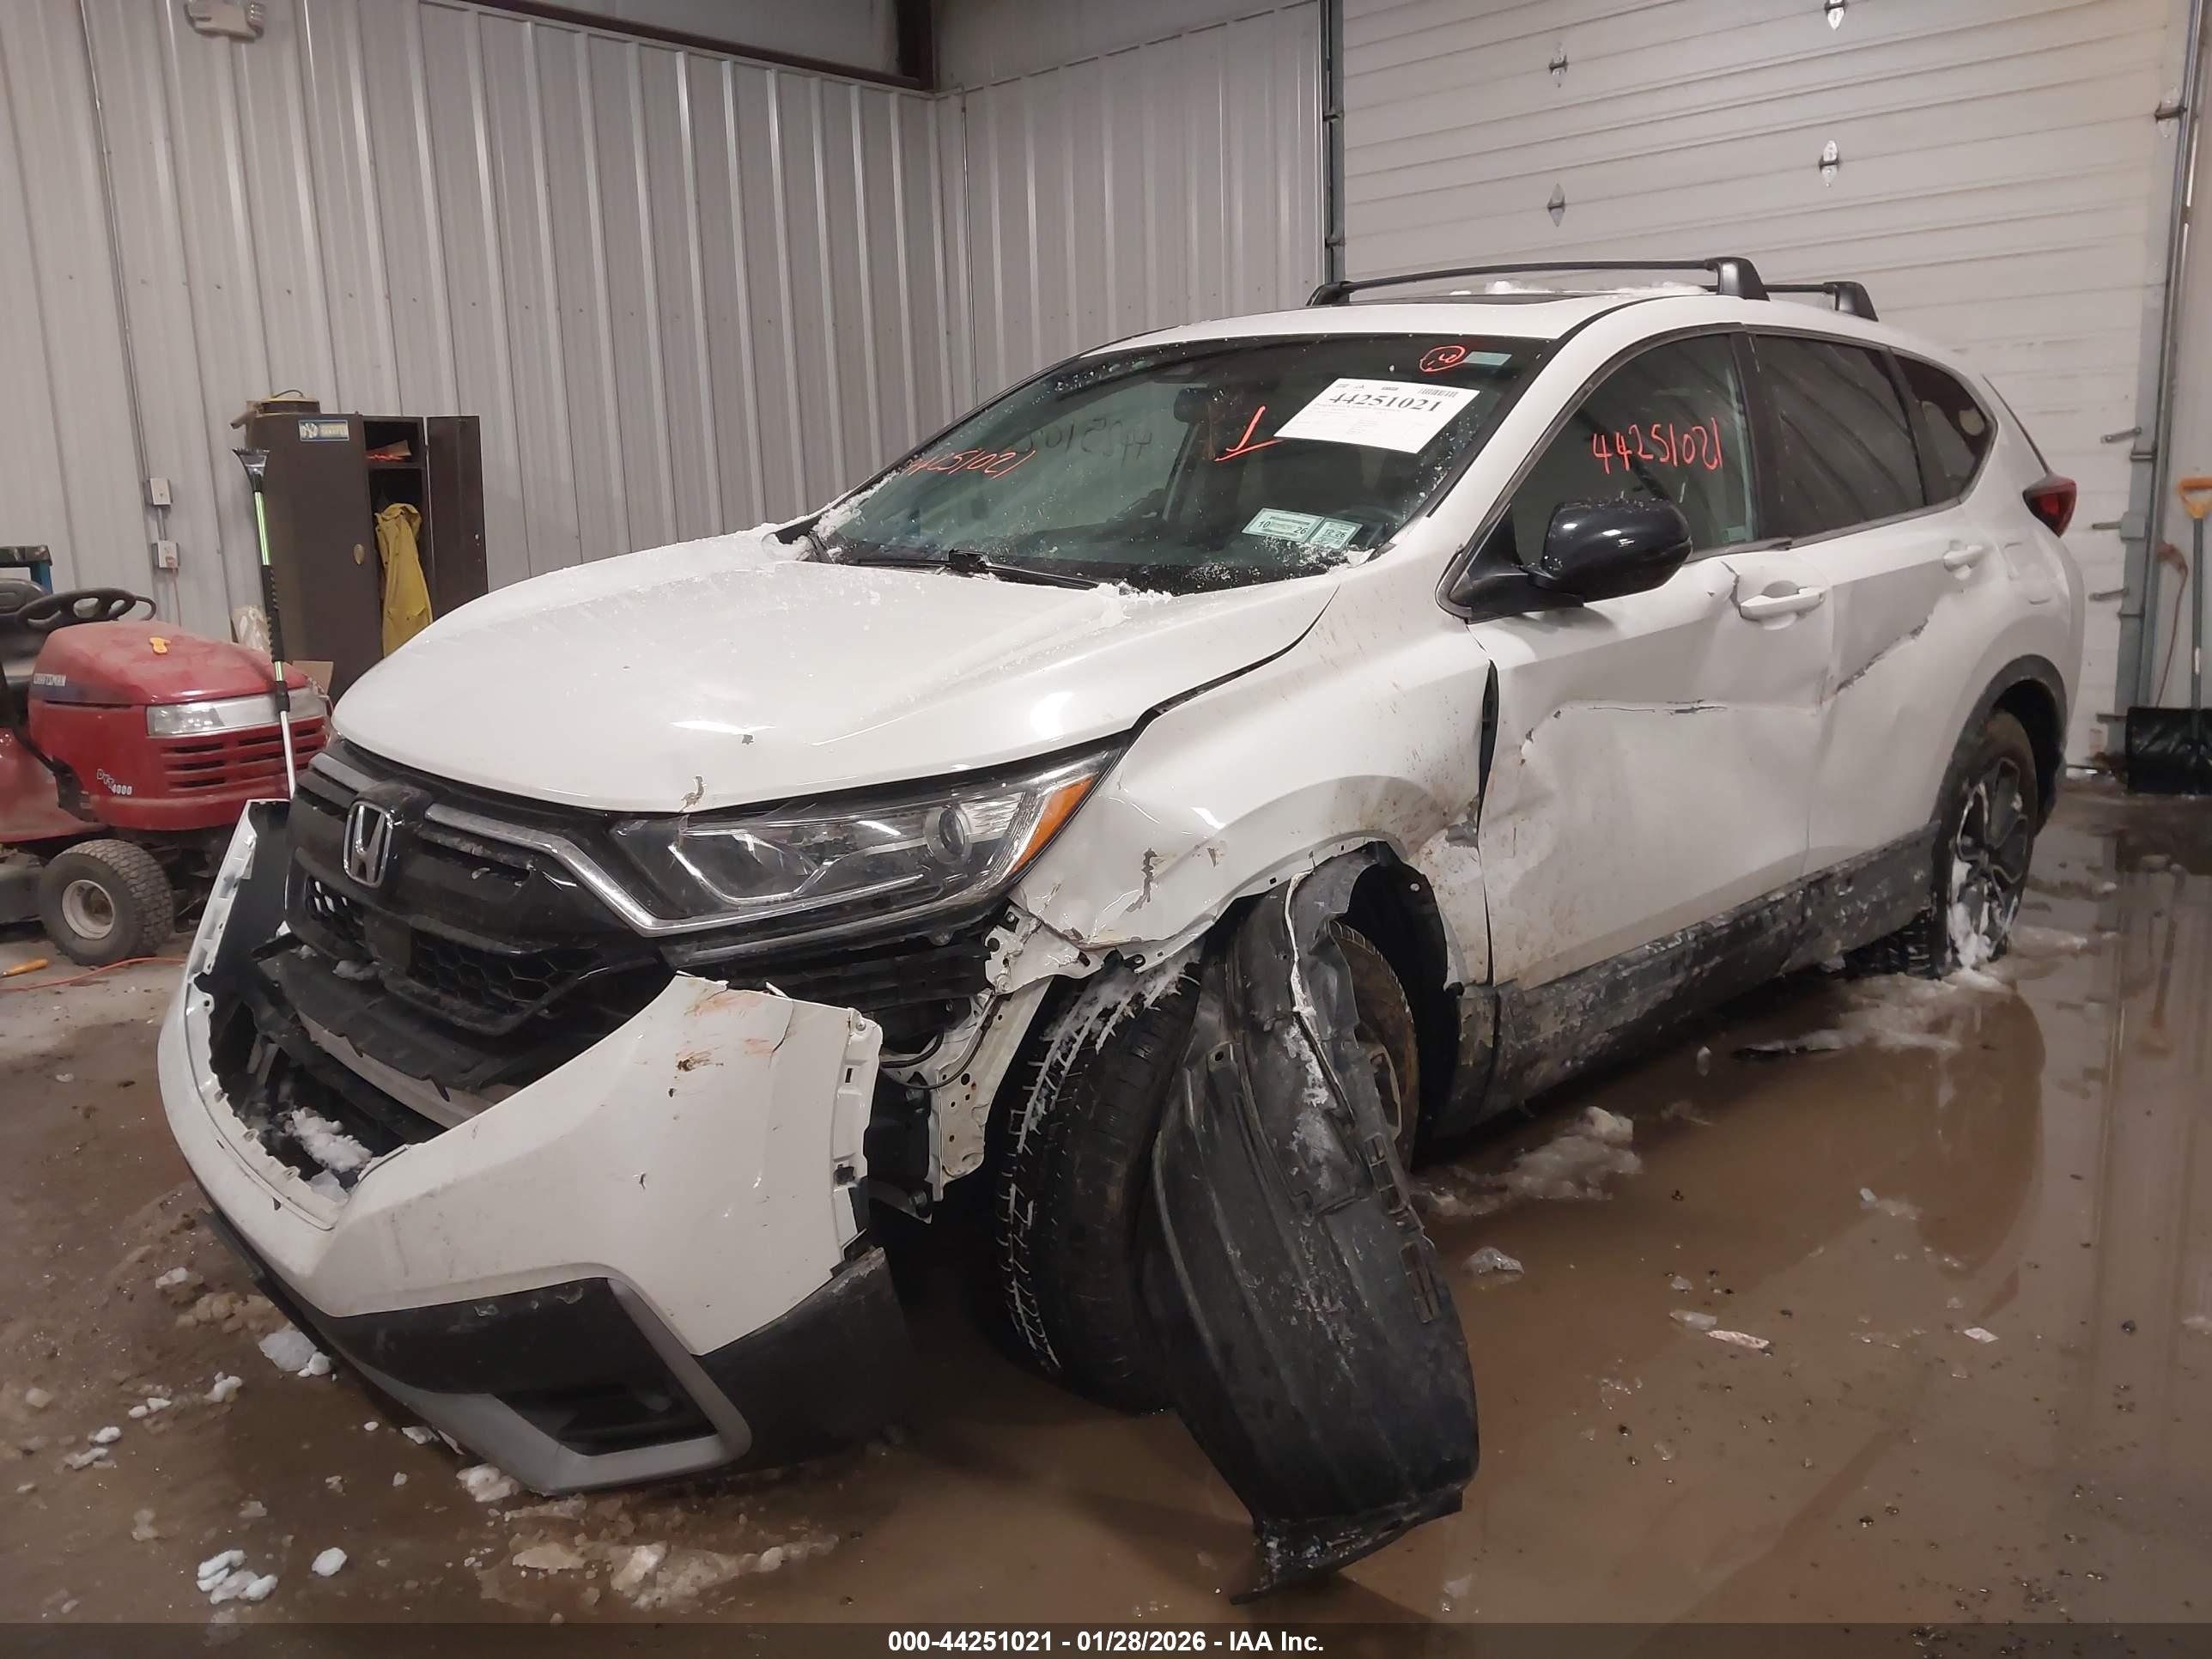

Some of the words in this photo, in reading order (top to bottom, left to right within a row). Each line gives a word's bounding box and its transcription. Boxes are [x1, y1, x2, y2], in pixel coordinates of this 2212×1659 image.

[1329, 392, 1443, 412] 44251021
[1593, 416, 1723, 475] 44251021
[1257, 520, 1271, 529] 10
[1294, 526, 1309, 535] 26
